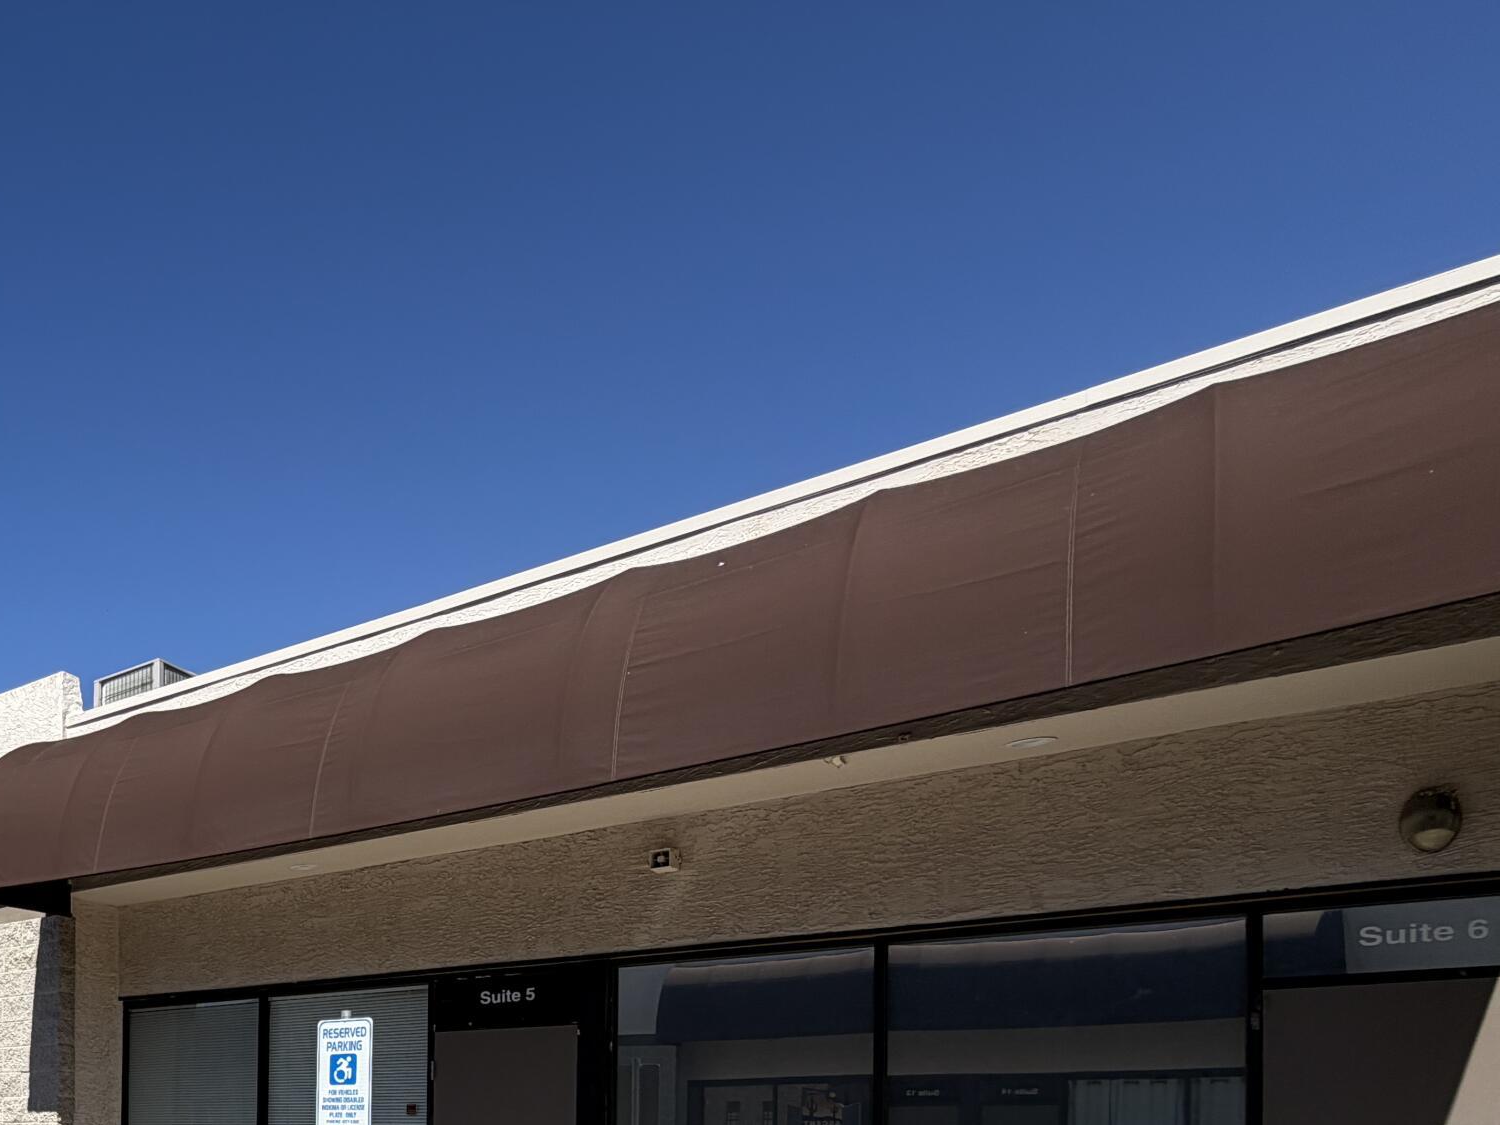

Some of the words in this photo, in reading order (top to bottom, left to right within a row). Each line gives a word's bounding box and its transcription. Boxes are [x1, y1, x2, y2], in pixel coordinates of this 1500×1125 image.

[1358, 923, 1455, 947] Suite
[1467, 919, 1490, 940] 6
[480, 989, 521, 1005] Suite
[525, 987, 535, 1001] 5
[322, 1027, 367, 1039] RESERVED
[326, 1040, 363, 1052] PARKING
